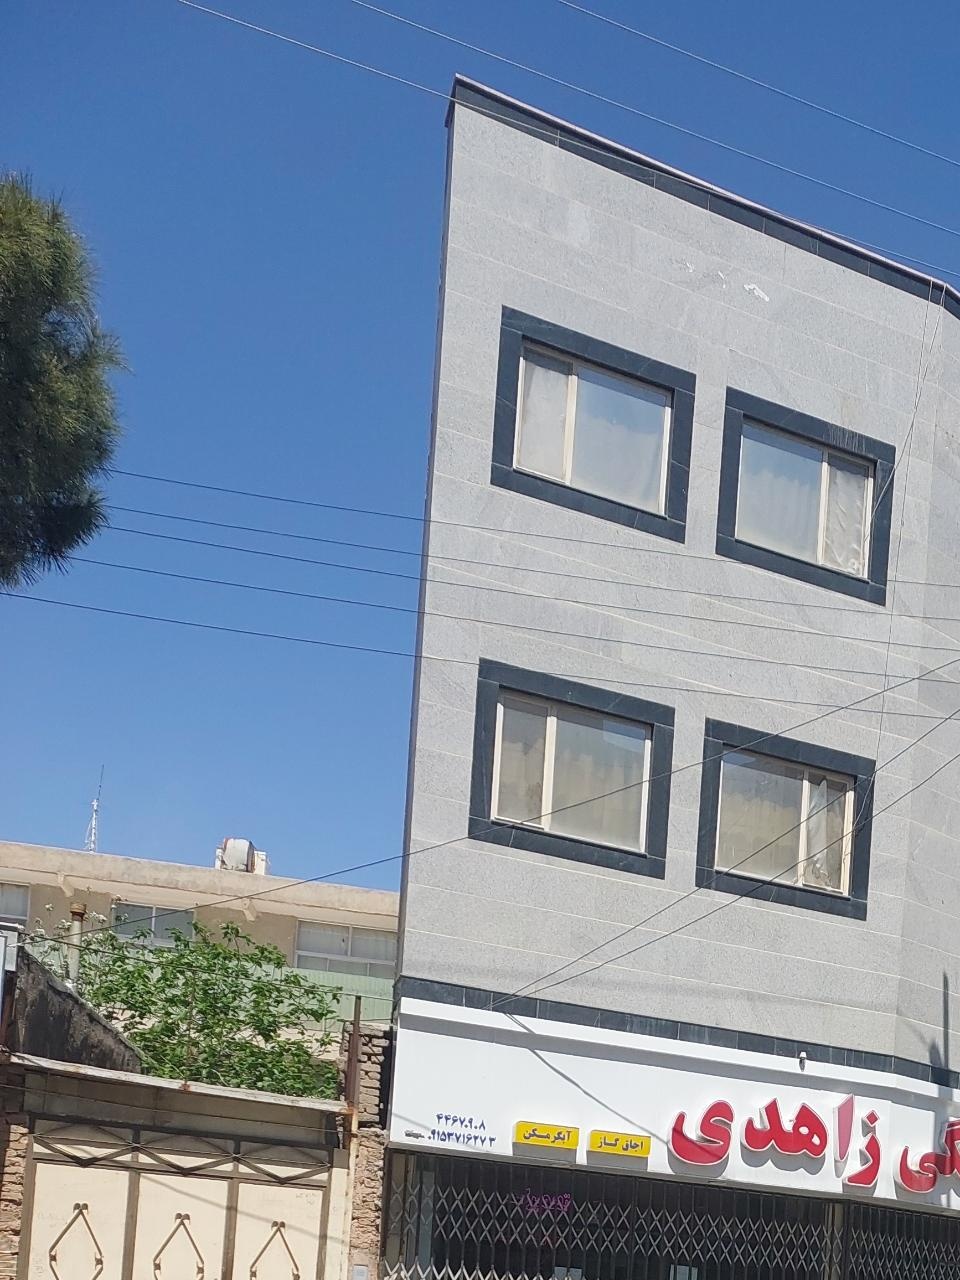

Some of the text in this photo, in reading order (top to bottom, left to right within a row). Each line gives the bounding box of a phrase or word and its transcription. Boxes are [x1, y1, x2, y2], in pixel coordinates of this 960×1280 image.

[597, 1136, 644, 1152] اجاق گاز
[669, 1094, 881, 1188] زاهدی
